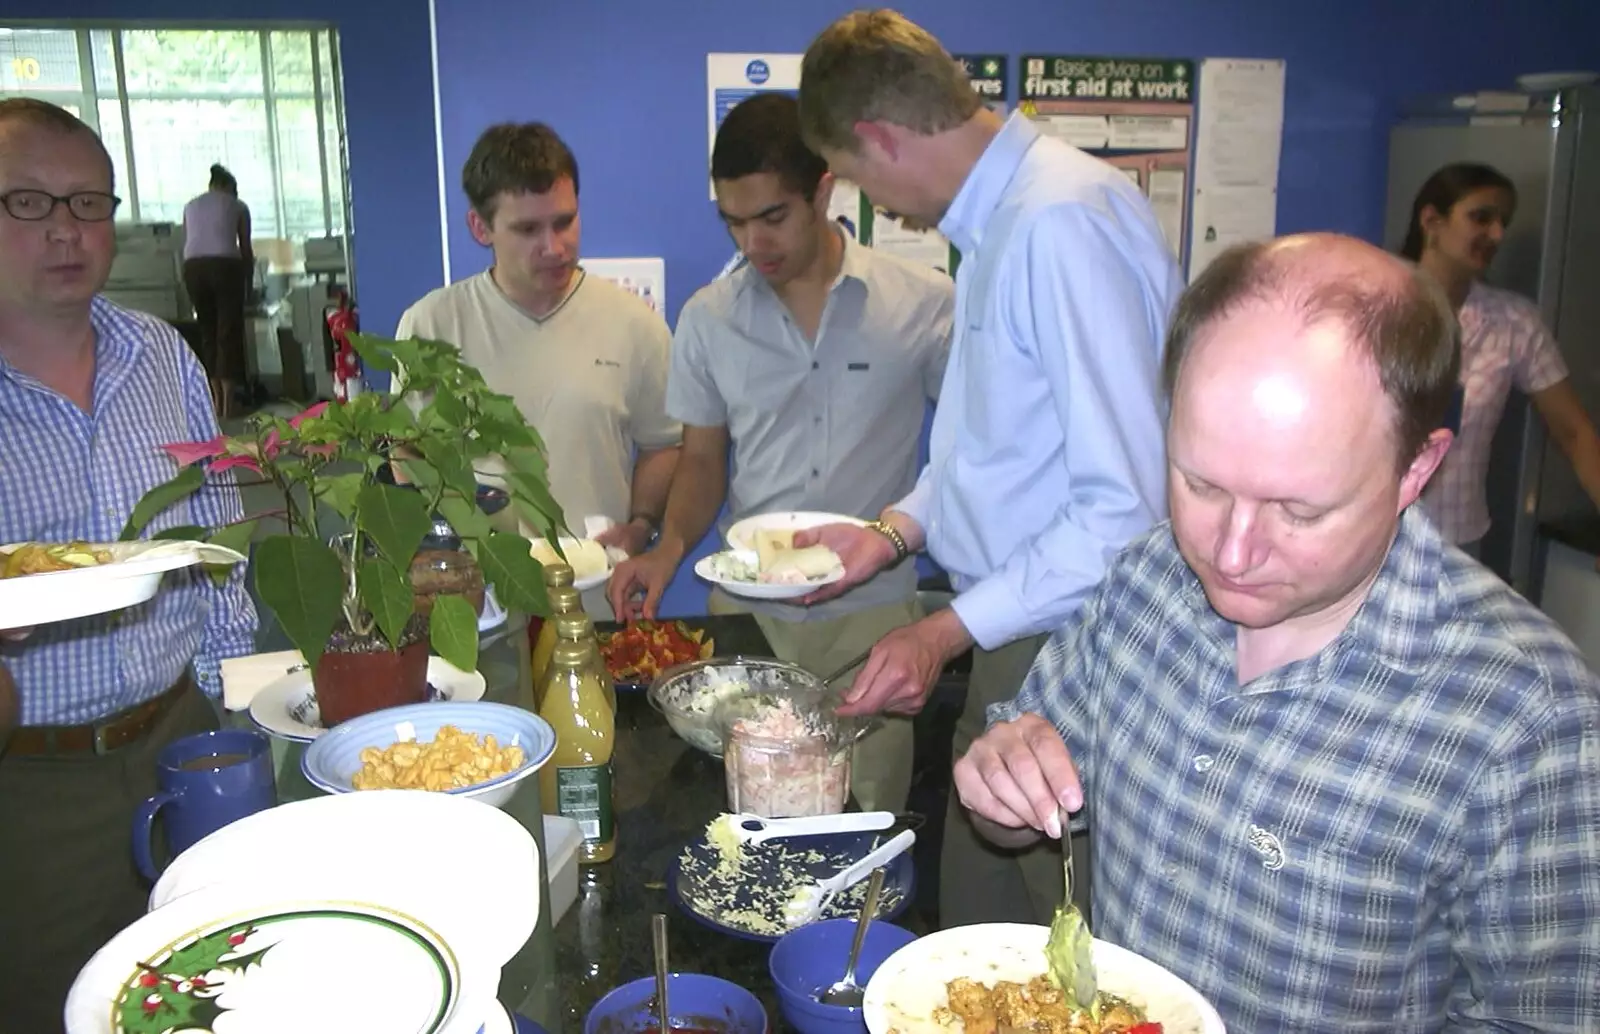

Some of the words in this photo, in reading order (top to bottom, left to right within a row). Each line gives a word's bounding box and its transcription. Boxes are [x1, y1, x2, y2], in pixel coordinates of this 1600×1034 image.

[12, 57, 40, 81] 10
[1054, 59, 1092, 77] Basic
[1094, 60, 1140, 78] advice
[1143, 65, 1163, 78] on
[1025, 75, 1072, 96] first
[1075, 76, 1107, 97] aid
[1111, 78, 1133, 97] at
[1137, 79, 1189, 99] work
